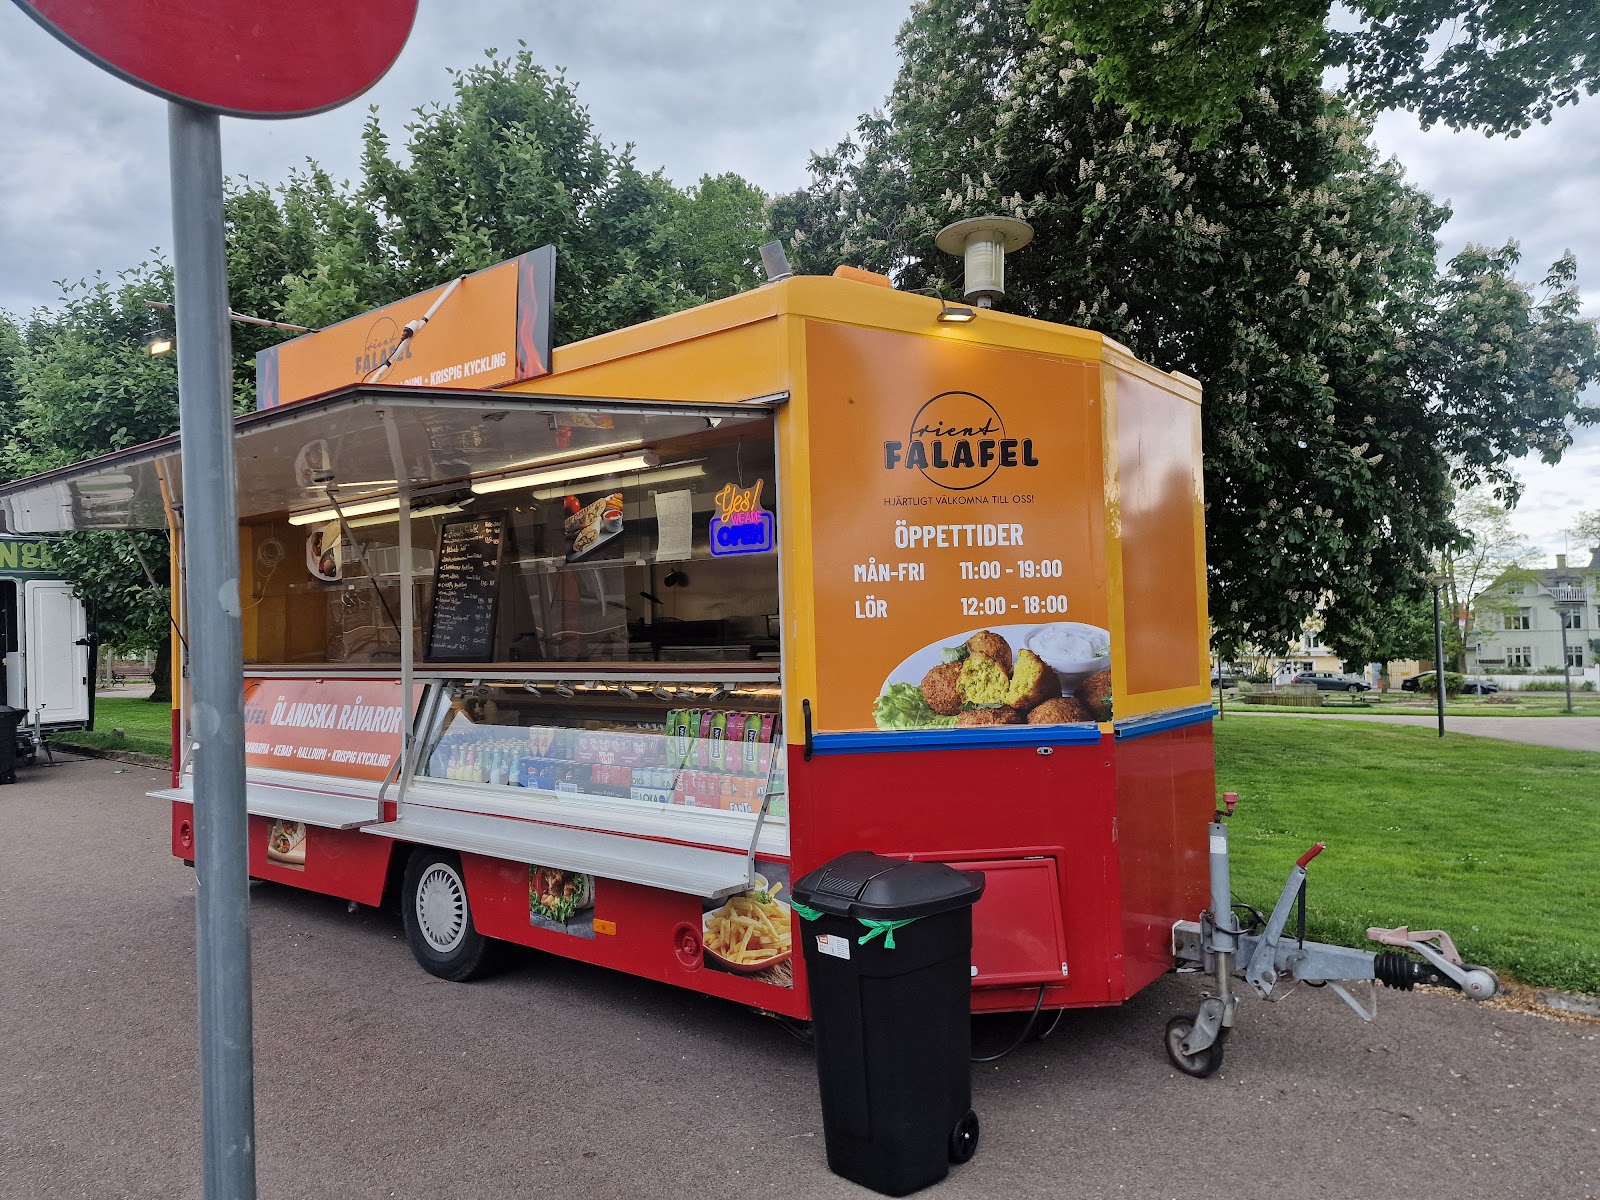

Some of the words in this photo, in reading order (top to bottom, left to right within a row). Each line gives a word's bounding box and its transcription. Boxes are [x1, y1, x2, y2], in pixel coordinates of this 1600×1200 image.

[430, 364, 462, 387] KRISPIG
[463, 351, 506, 377] KYCKLING
[884, 438, 1039, 470] FALAFEL
[715, 480, 761, 523] Yes!
[884, 495, 933, 506] HJÄRTLIGT
[936, 494, 989, 505] VÄLKOMNA
[992, 495, 1009, 504] TILL
[1012, 494, 1034, 504] OSS!
[731, 512, 745, 525] WE
[745, 510, 762, 523] ARE
[717, 522, 765, 547] OPEN
[895, 519, 1024, 549] ÖPPETTIDER
[854, 557, 925, 583] MÅN-FRI
[959, 560, 1001, 580] 11:00
[1017, 559, 1063, 579] 19:00
[855, 594, 888, 619] LÖR
[961, 596, 1006, 616] 12:00
[1022, 595, 1068, 614] 18:00
[270, 695, 336, 729] ÖLANDSKA
[337, 695, 402, 734] RÅVAROR
[273, 744, 294, 757] KEBAB
[296, 746, 328, 761] HALLOUMI
[331, 749, 357, 764] KRISPIG
[356, 751, 391, 767] KYCKLING
